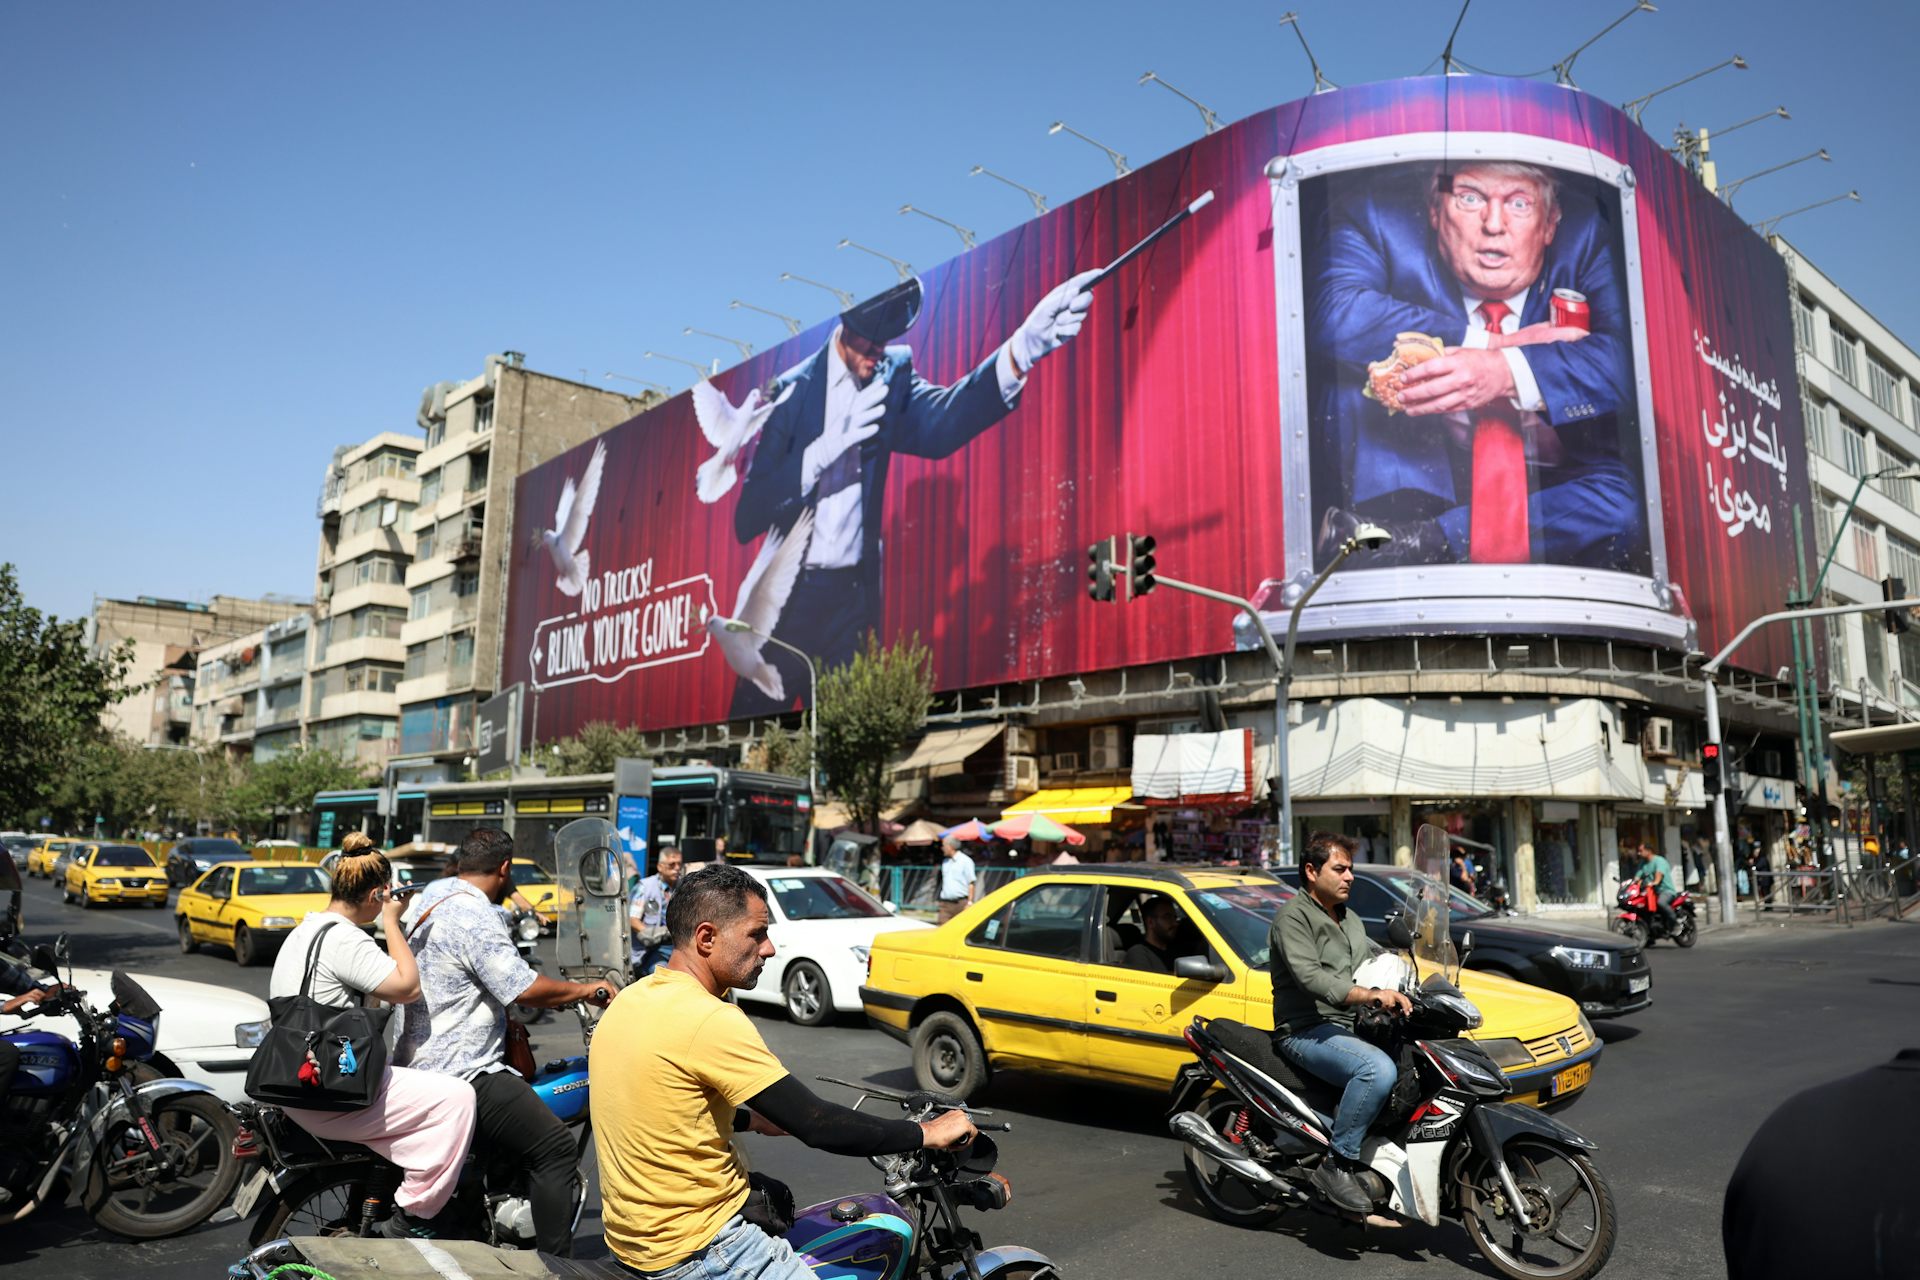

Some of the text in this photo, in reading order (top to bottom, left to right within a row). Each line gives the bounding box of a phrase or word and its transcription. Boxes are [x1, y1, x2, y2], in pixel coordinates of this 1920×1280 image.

[1742, 367, 1781, 411] شعبده
[1702, 390, 1787, 492] پلک بزنی
[1706, 461, 1771, 538] محوی!
[581, 557, 653, 615] NO TRICKS!
[547, 593, 691, 677] BLINK, YOU'RE GONE!
[1438, 1095, 1466, 1107] CRYSTAL
